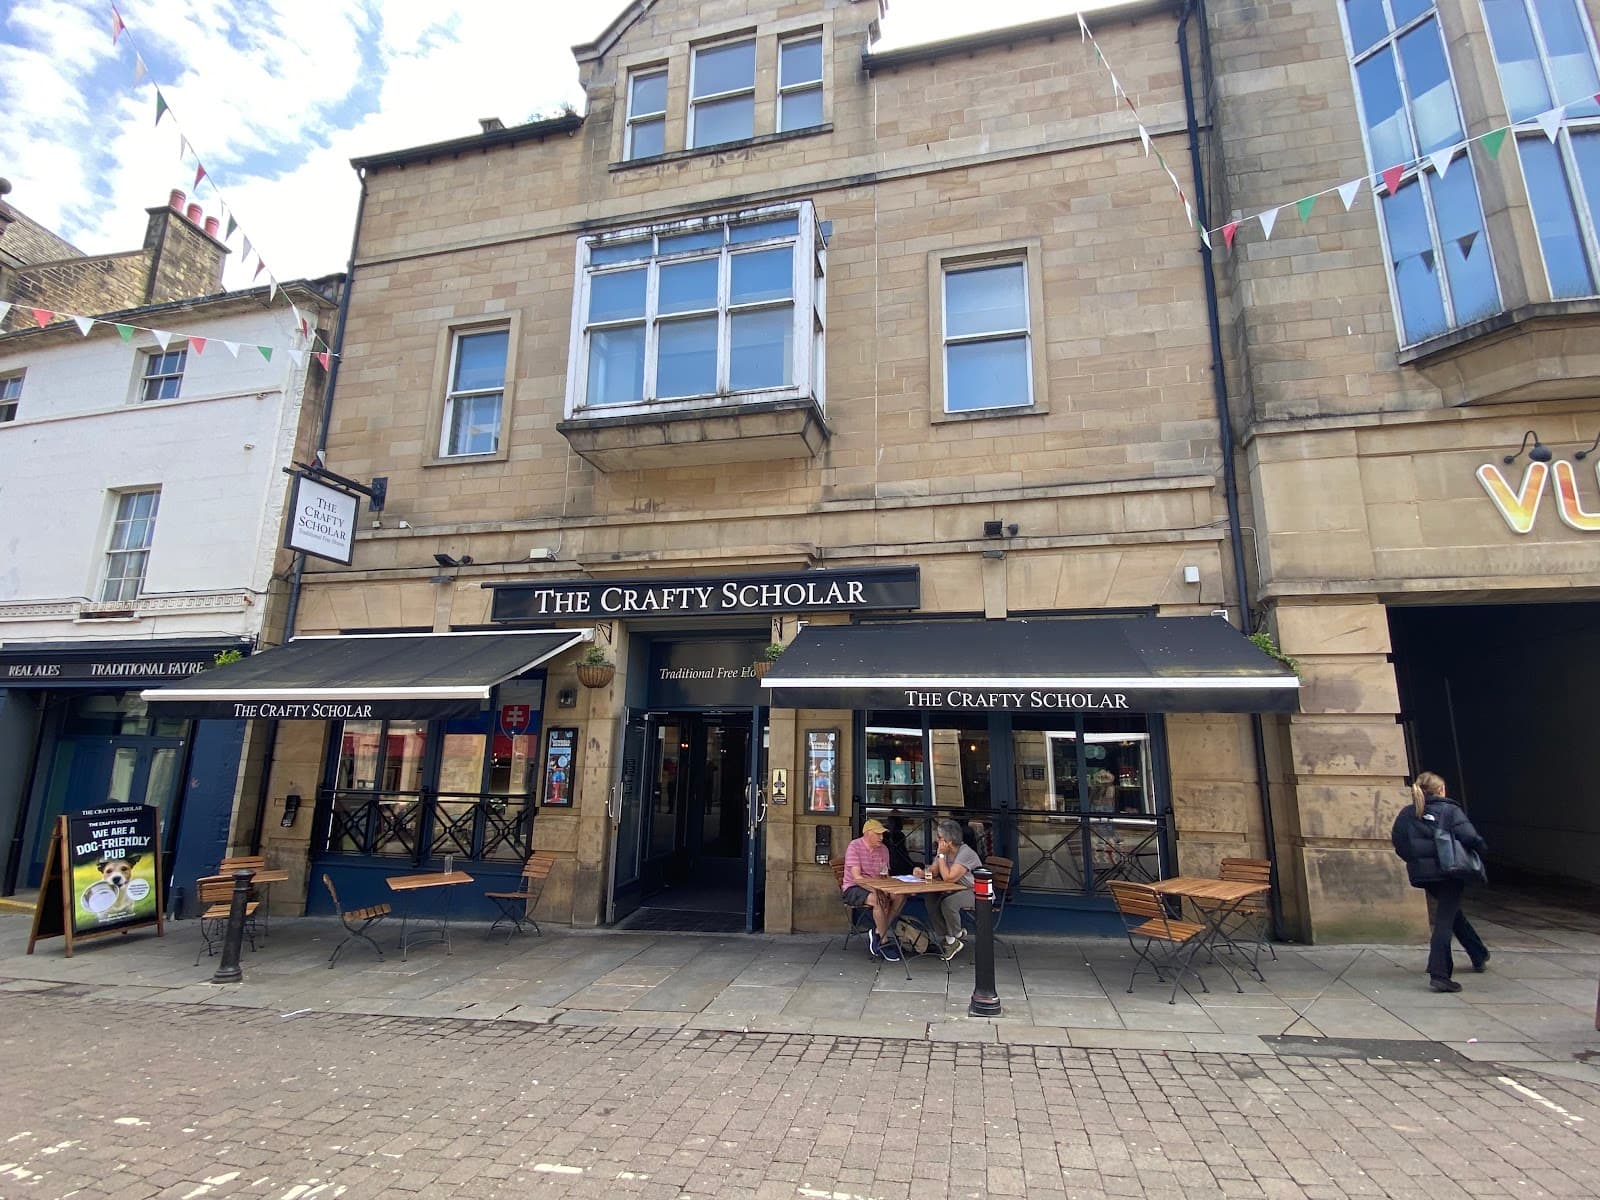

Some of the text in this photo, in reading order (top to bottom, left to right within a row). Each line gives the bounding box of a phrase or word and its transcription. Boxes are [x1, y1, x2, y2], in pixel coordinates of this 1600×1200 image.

[316, 497, 337, 513] THE
[304, 505, 344, 527] CRAFTY
[299, 516, 346, 540] SCHOLAR
[535, 581, 867, 613] THE CRAFTY SCHOLAR
[8, 665, 60, 676] REAL ALES
[91, 662, 204, 675] TRADITIONAL FAYRE
[660, 666, 757, 679] Traditional Free Ho
[905, 690, 1129, 709] THE CRAFTY SCHOLAR
[234, 703, 372, 717] THE CRAFTY SCHOLAR
[92, 826, 135, 838] WE ARE A
[76, 836, 151, 855] DOG-FRIENDLY
[104, 849, 126, 860] PUB
